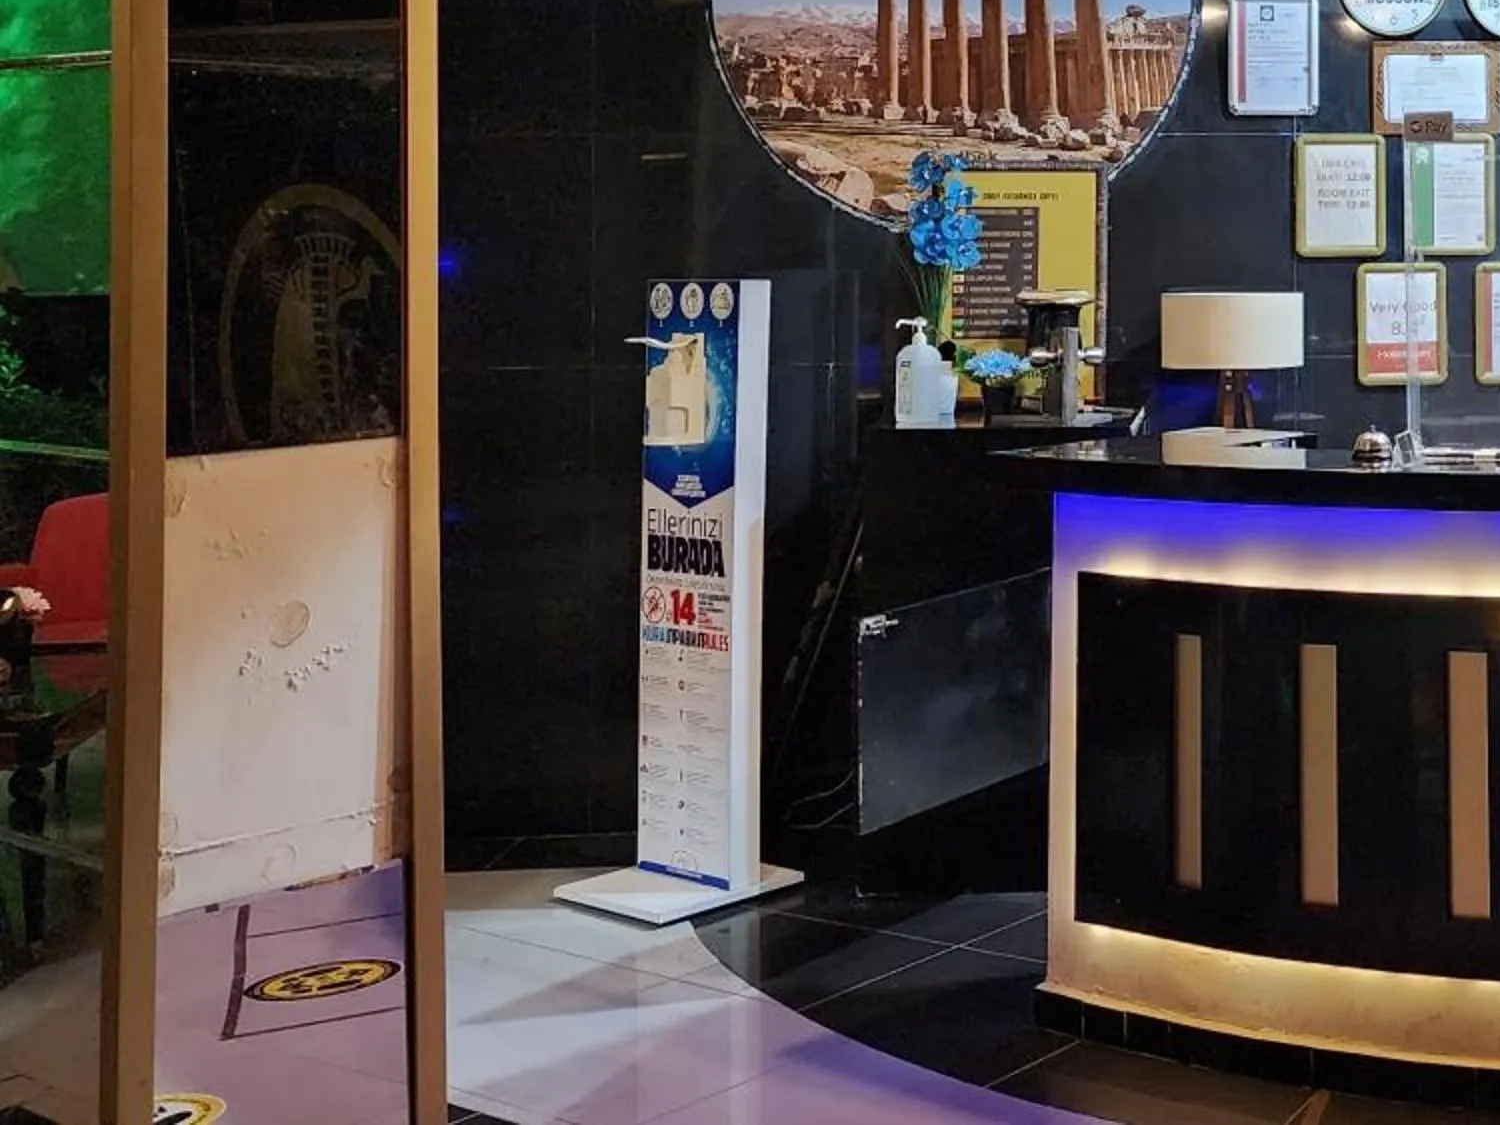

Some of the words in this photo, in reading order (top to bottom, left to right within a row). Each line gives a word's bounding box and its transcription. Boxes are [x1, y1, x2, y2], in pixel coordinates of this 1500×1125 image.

[1425, 119, 1449, 134] Pay
[1369, 301, 1398, 313] Very
[647, 508, 723, 539] Ellerinizi
[647, 534, 725, 577] BURADA
[671, 589, 696, 625] 14
